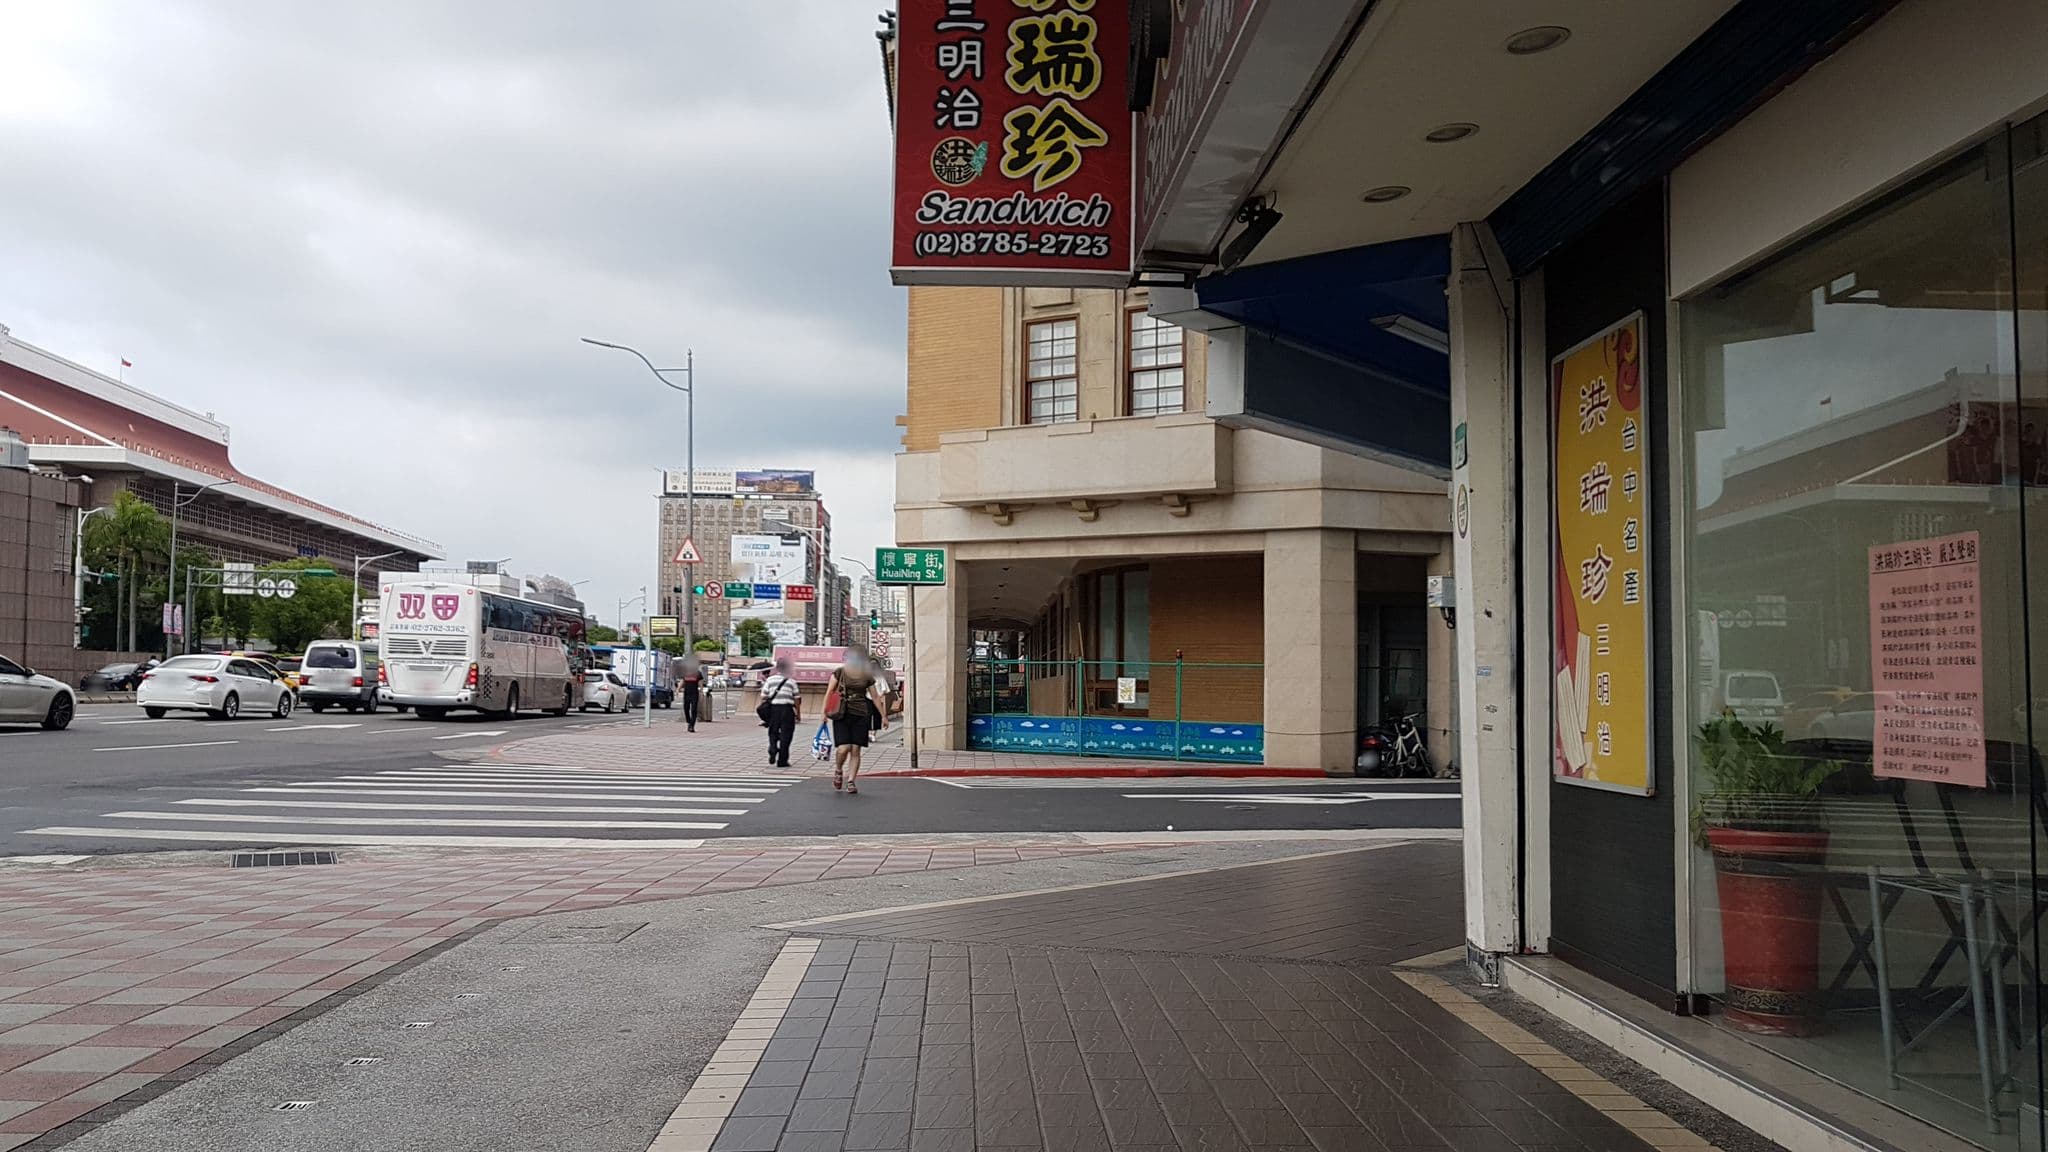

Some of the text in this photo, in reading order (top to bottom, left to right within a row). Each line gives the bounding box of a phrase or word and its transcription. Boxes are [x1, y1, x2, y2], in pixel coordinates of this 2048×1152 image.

[936, 0, 986, 128] 三明治
[1000, 0, 1108, 193] 瑞珍
[916, 191, 1111, 226] Sandwich
[916, 232, 1109, 257] (02)8785-2723
[1621, 417, 1640, 605] 台中名產
[881, 567, 938, 580] HuaiNing St.
[882, 551, 939, 568] 懷寧街
[1580, 376, 1612, 756] 洪瑞珍 三明治
